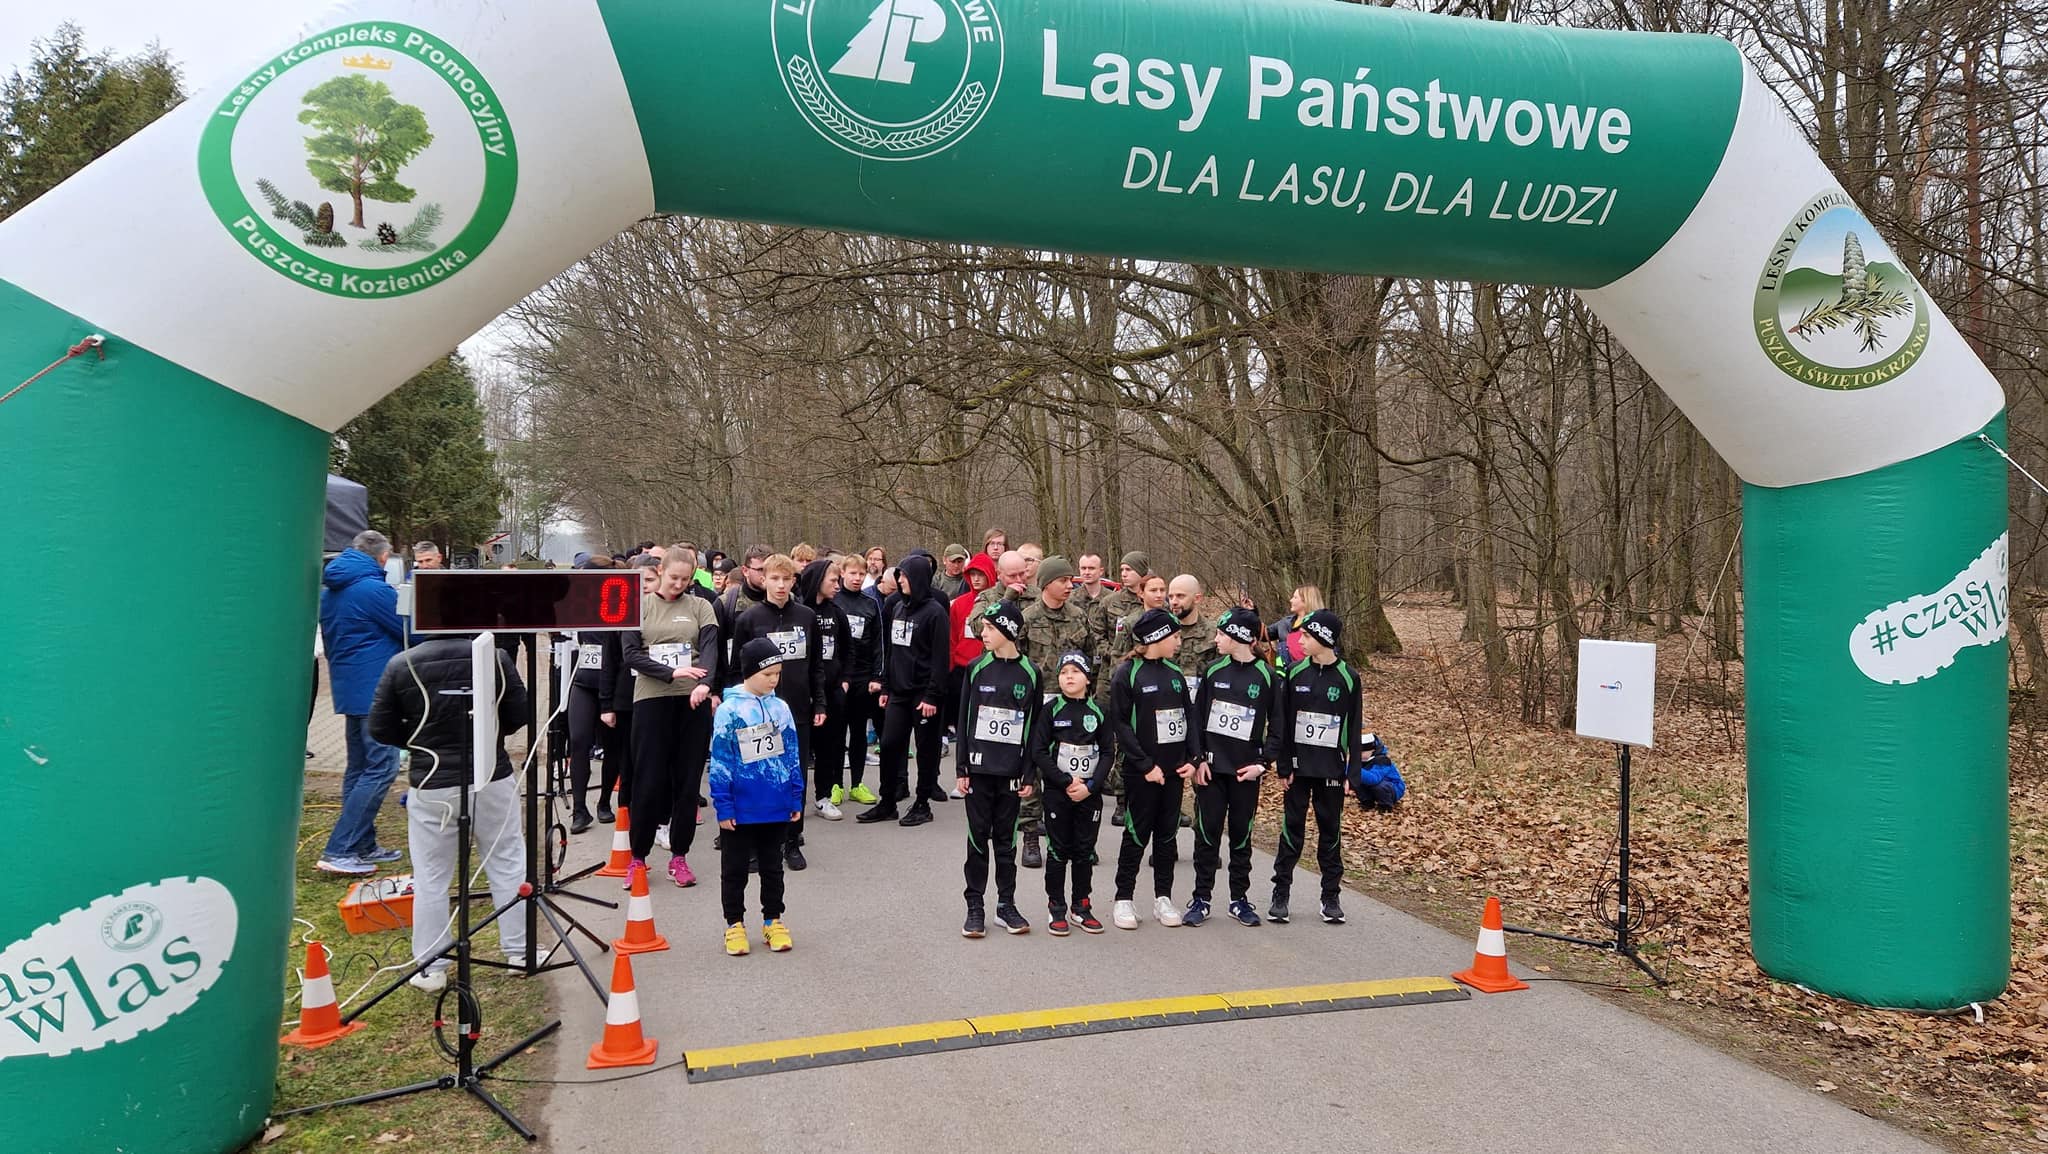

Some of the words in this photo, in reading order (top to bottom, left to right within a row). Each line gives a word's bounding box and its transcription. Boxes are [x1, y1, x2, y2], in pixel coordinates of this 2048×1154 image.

[219, 65, 276, 118] Leśny
[281, 26, 397, 66] Kompleks
[405, 32, 506, 157] Promocyjny
[1042, 29, 1222, 132] Lasy
[1248, 55, 1631, 154] Państwowe
[1123, 146, 1217, 196] DLA
[1239, 159, 1365, 213] LASU,
[1384, 171, 1473, 217] DLA
[1490, 180, 1617, 226] LUDZI
[233, 215, 333, 288] Puszcza
[341, 249, 467, 294] Kozienicka
[1762, 232, 1797, 291] LEŚNY
[1759, 318, 1802, 376] PUSZCZA
[1803, 322, 1928, 389] ŚWIĘTOKRZYSKA
[600, 577, 629, 623] 0
[1870, 581, 1982, 655] #czas
[585, 654, 598, 664] 26
[661, 655, 679, 666] 51
[779, 642, 797, 654] 55
[989, 720, 1010, 736] 96
[1169, 722, 1184, 736] 95
[1219, 715, 1240, 731] 98
[1306, 725, 1327, 739] 97
[752, 736, 774, 753] 73
[1070, 758, 1090, 771] 99
[5, 936, 201, 1044] wlas
